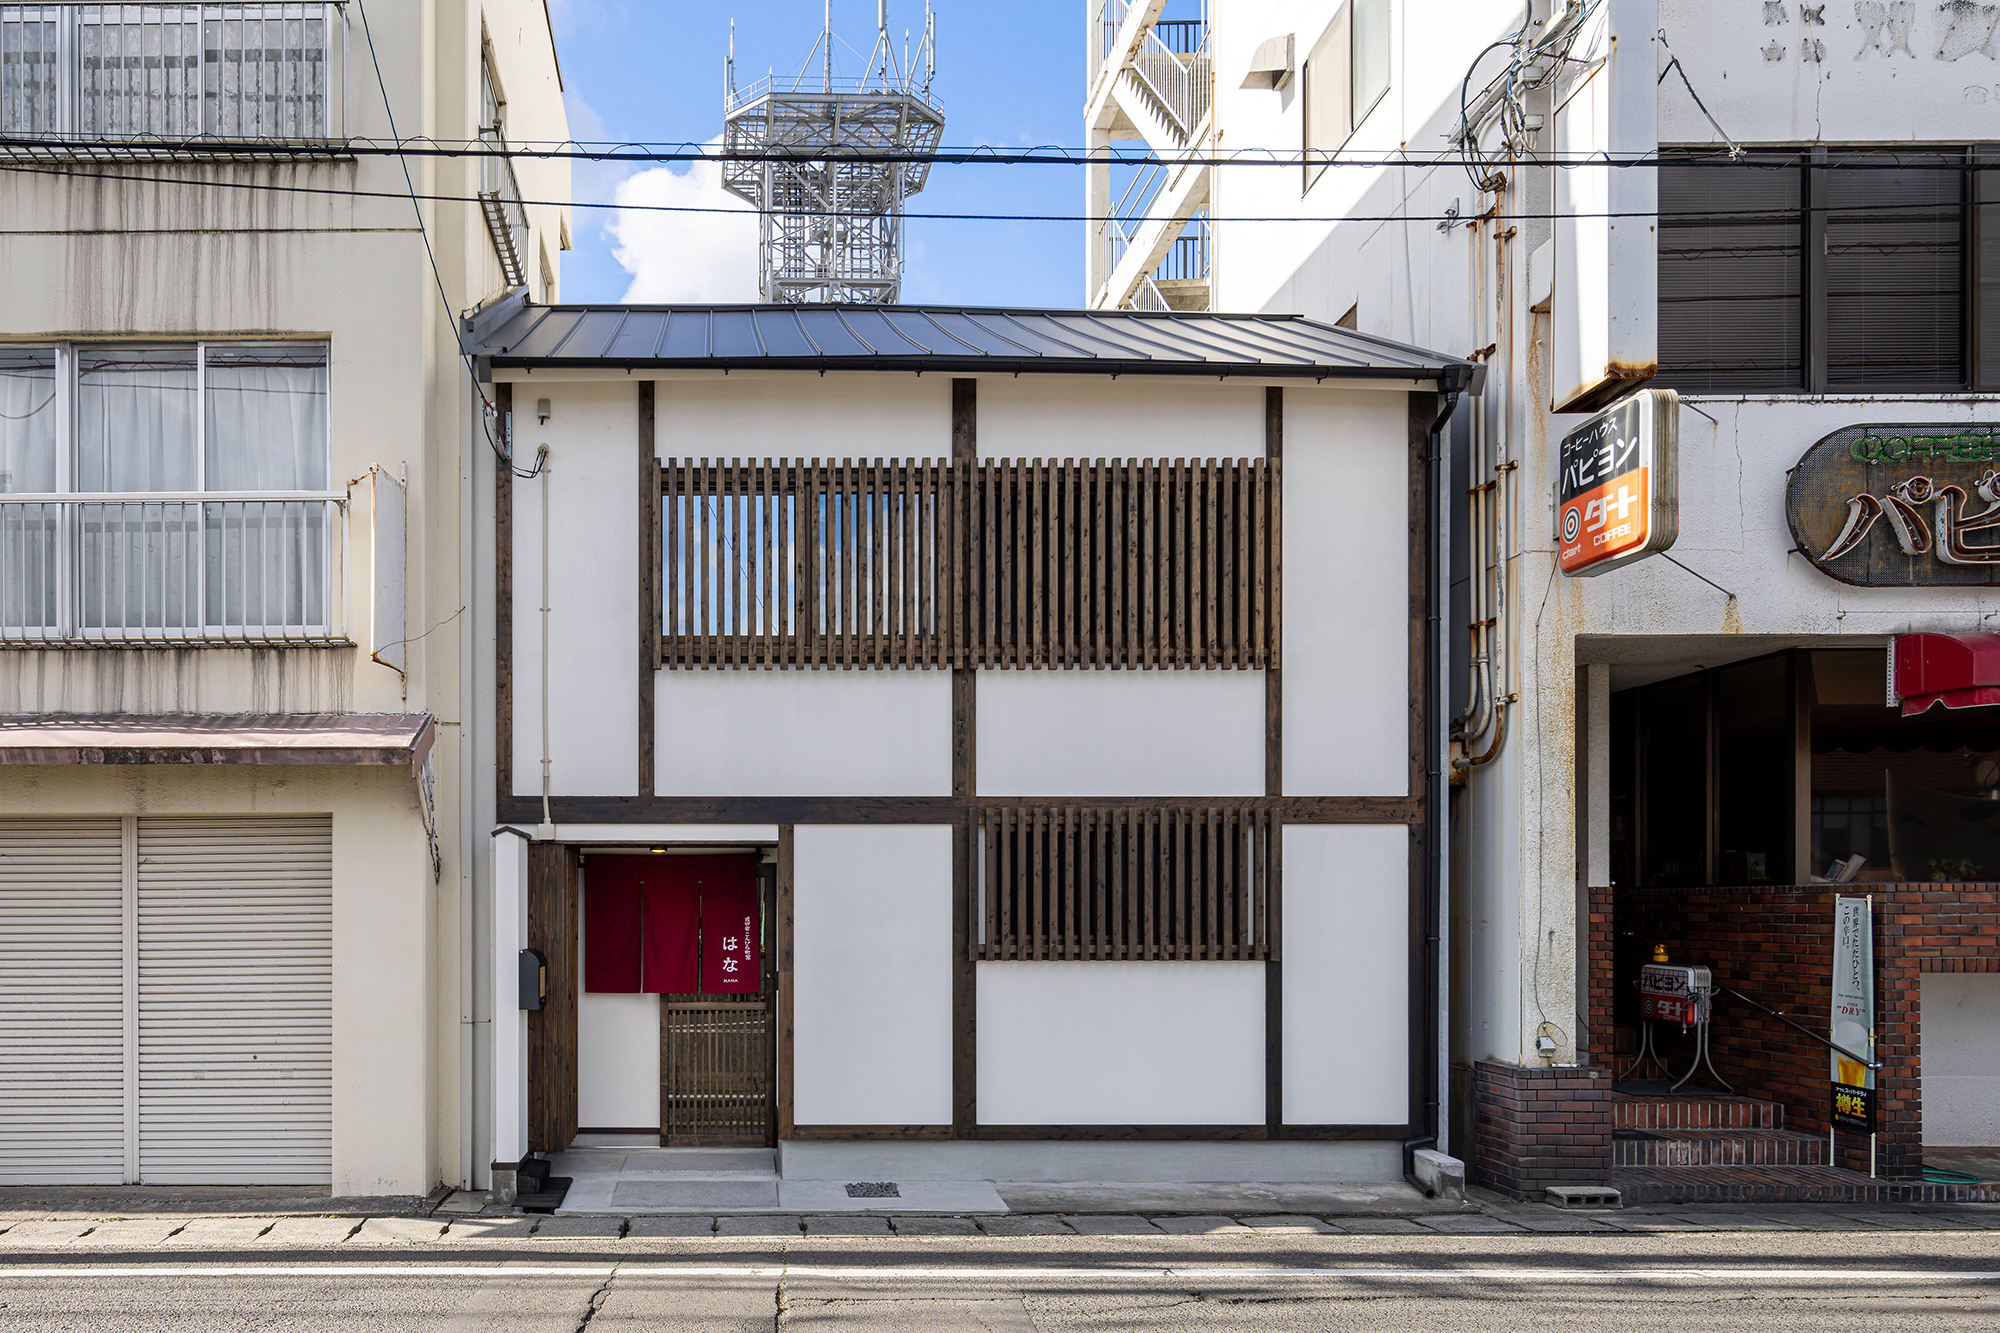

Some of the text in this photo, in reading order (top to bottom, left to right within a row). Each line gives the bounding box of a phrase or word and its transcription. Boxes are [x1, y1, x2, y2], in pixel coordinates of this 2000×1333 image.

[1563, 416, 1618, 457] コーヒーハウス
[1562, 437, 1638, 495] パピヨン
[1593, 522, 1632, 547] COFFEE
[1562, 543, 1582, 560] dart
[722, 936, 738, 972] はな
[1836, 1093, 1867, 1118] 樽生
